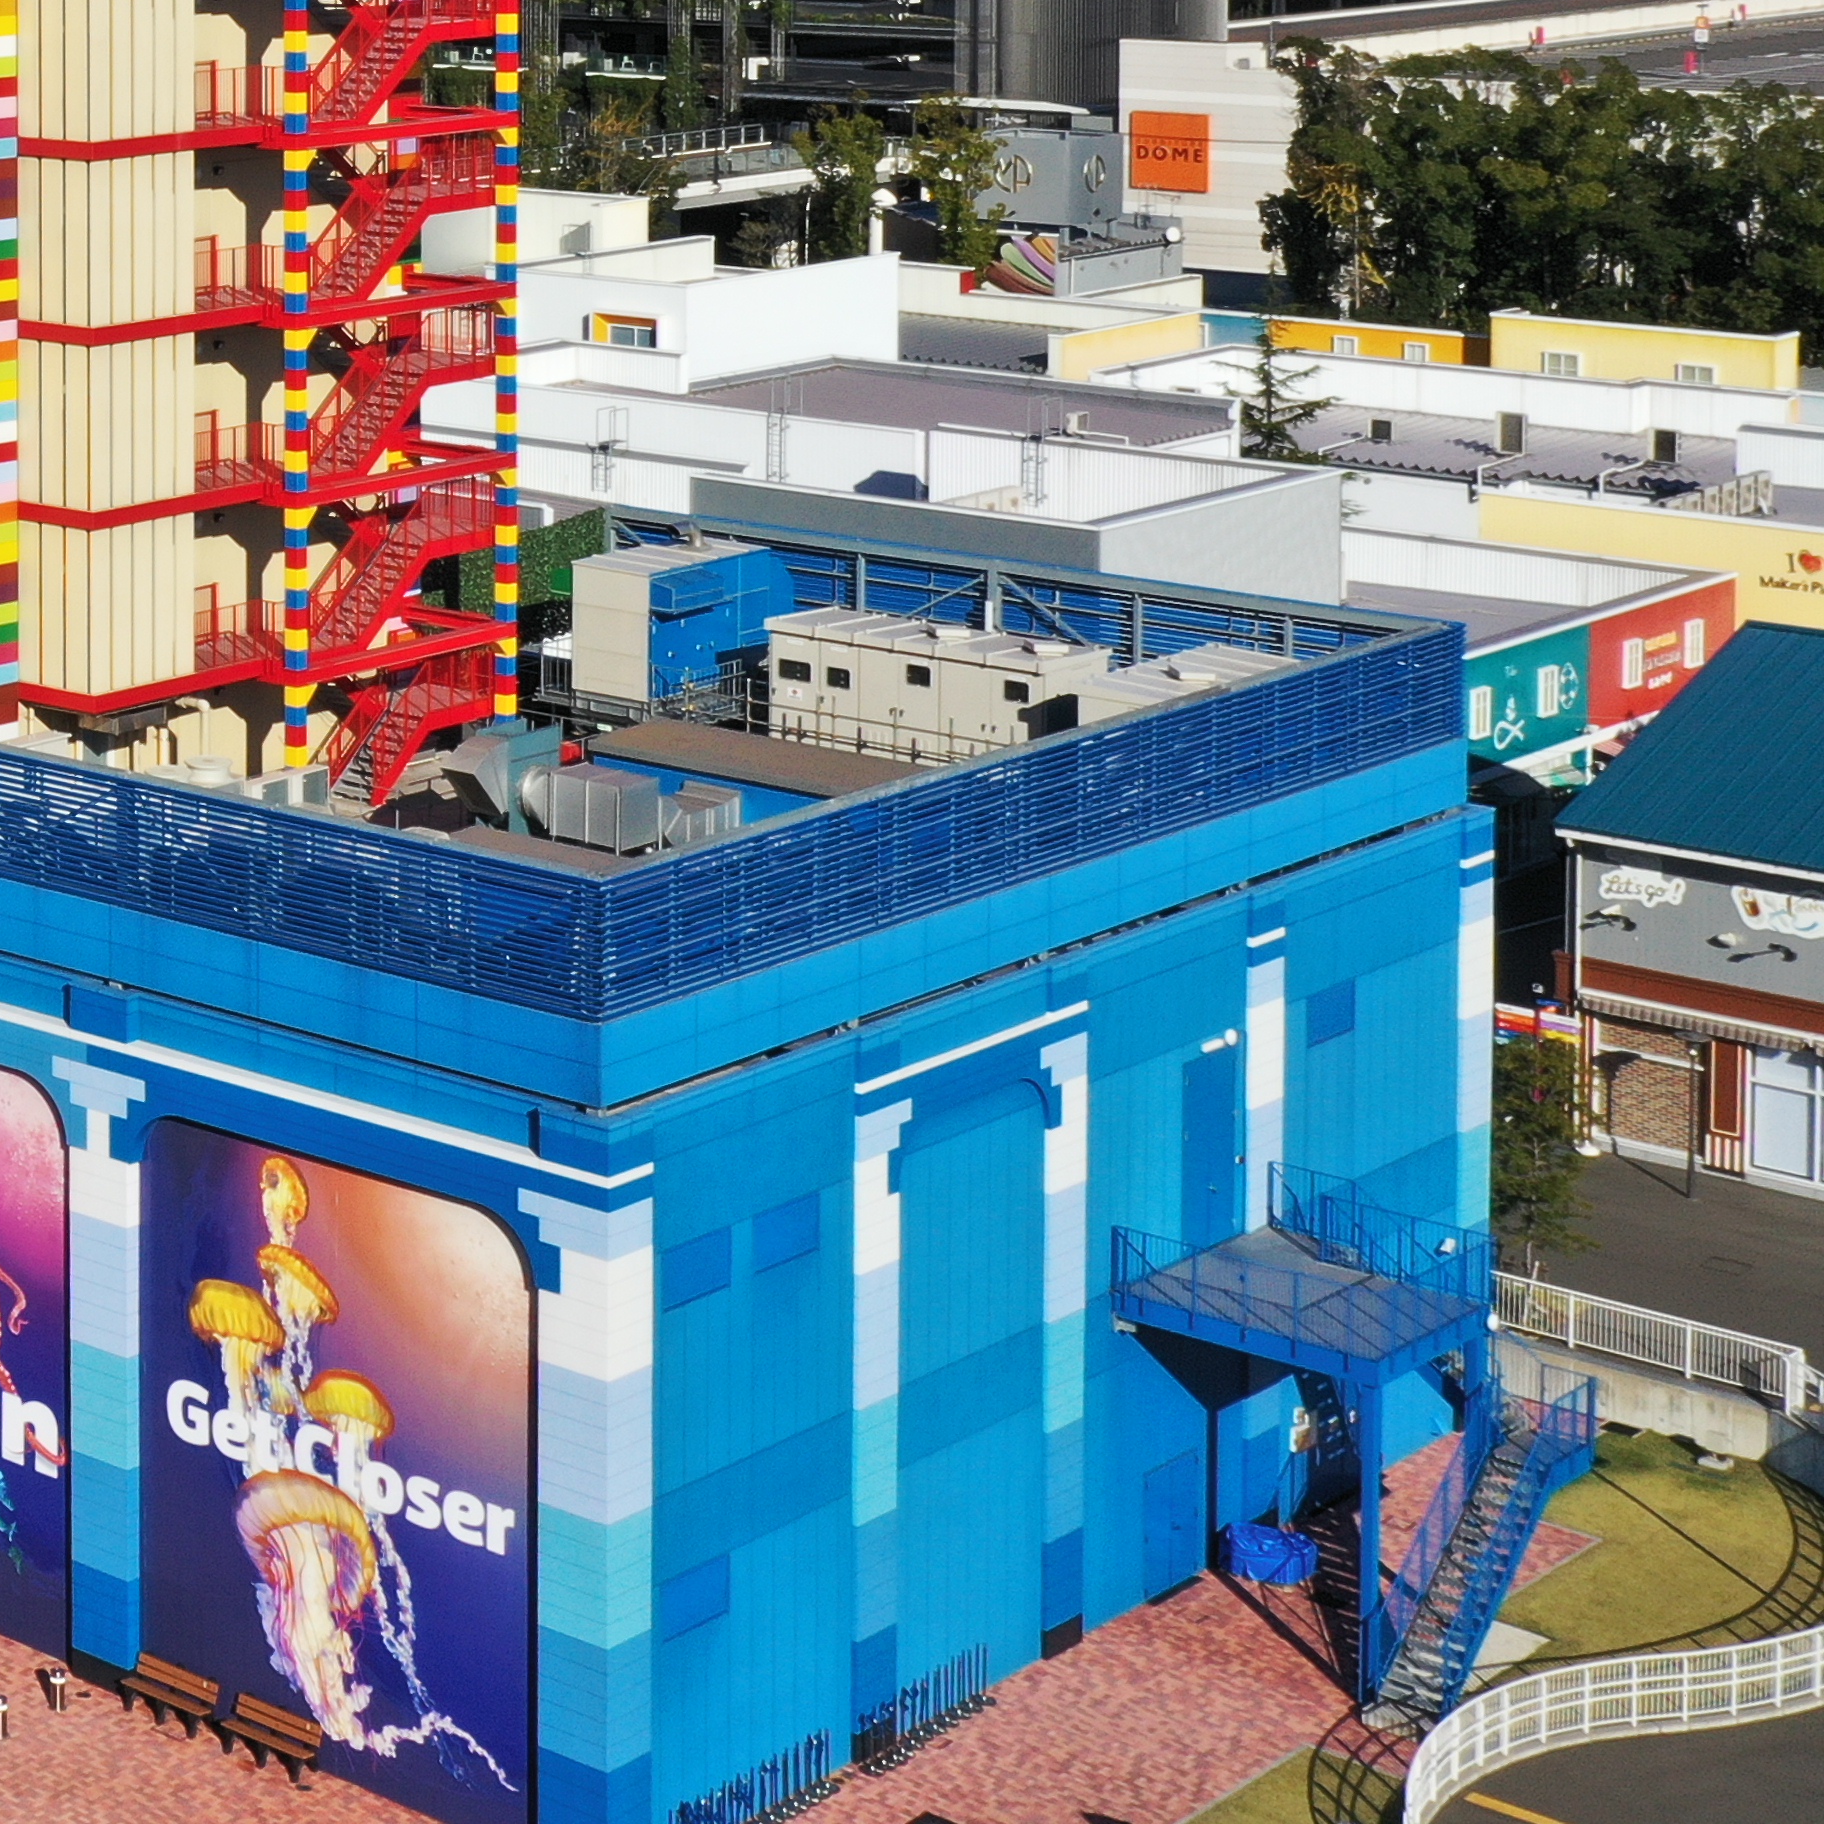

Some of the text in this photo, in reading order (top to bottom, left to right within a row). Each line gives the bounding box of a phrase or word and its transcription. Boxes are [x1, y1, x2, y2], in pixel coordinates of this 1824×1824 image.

[1136, 144, 1204, 164] DOME
[166, 1379, 516, 1556] Get Closer
